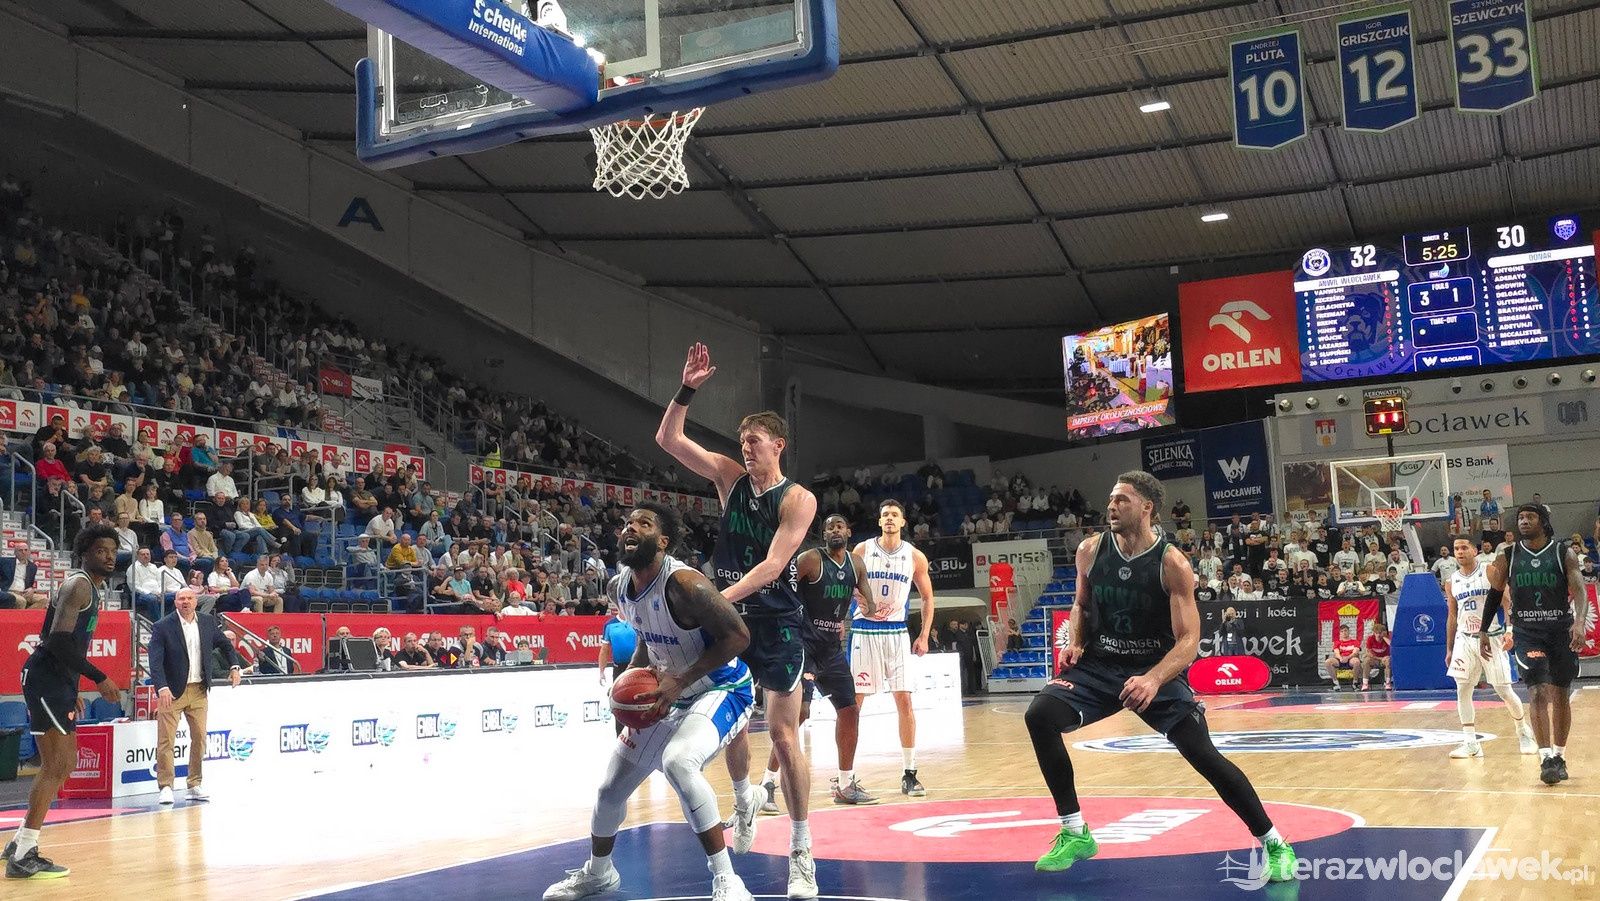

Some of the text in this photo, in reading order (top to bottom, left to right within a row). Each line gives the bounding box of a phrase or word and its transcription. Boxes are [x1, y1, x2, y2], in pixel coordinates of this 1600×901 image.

[1452, 3, 1524, 26] SZEWCZYK
[1365, 20, 1382, 30] IGOR
[1340, 25, 1409, 47] GRISZCZUK
[1250, 40, 1280, 50] ANDRZEJ
[1246, 50, 1285, 64] PLUTA
[1457, 28, 1528, 82] 33
[1348, 50, 1408, 103] 12
[1238, 70, 1297, 121] 10
[336, 196, 384, 232] A
[1443, 232, 1449, 240] 2
[1496, 225, 1526, 248] 30
[1350, 245, 1376, 268] 32
[1422, 244, 1458, 260] 5:25
[1420, 288, 1459, 306] 3 1
[1202, 347, 1282, 372] ORLEN
[1148, 445, 1194, 466] SELENKA
[1466, 456, 1494, 467] Bank
[1212, 486, 1262, 500] WŁOCŁAWEK
[942, 560, 967, 570] BUD
[882, 584, 888, 596] 0
[1464, 600, 1476, 611] 20
[1535, 592, 1542, 606] 2
[834, 604, 840, 618] 4
[1268, 606, 1296, 617] kości
[1100, 634, 1160, 648] GRONINGEN
[281, 727, 307, 751] ENBL
[353, 721, 378, 744] ENBL
